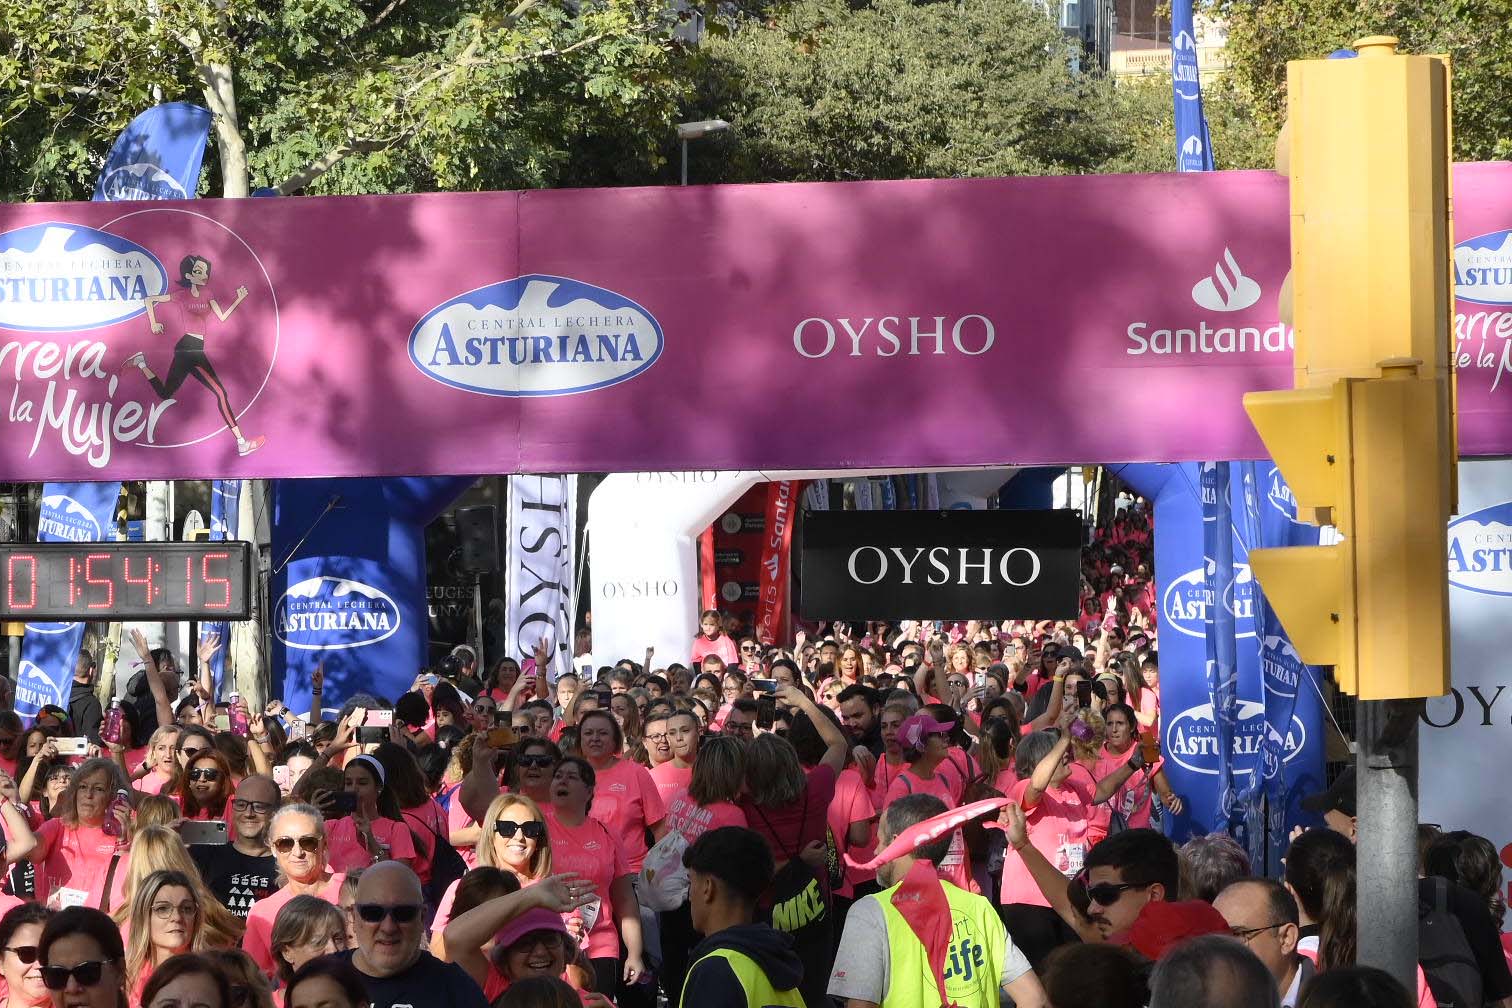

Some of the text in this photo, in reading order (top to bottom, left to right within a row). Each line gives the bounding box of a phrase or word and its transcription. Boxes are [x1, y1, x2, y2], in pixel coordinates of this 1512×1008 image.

[467, 315, 636, 331] CENTRAL LECHERA
[793, 313, 996, 359] OYSHO
[1127, 321, 1294, 355] Santand
[427, 321, 644, 367] ASTURIANA
[1477, 341, 1494, 368] la
[8, 382, 33, 423] la
[29, 373, 177, 469] Mujer
[38, 517, 92, 542] STURIANA
[847, 545, 1042, 587] OYSHO
[602, 578, 679, 600] OYSHO
[279, 614, 390, 633] ASTURIANA
[772, 877, 825, 933] NIKE
